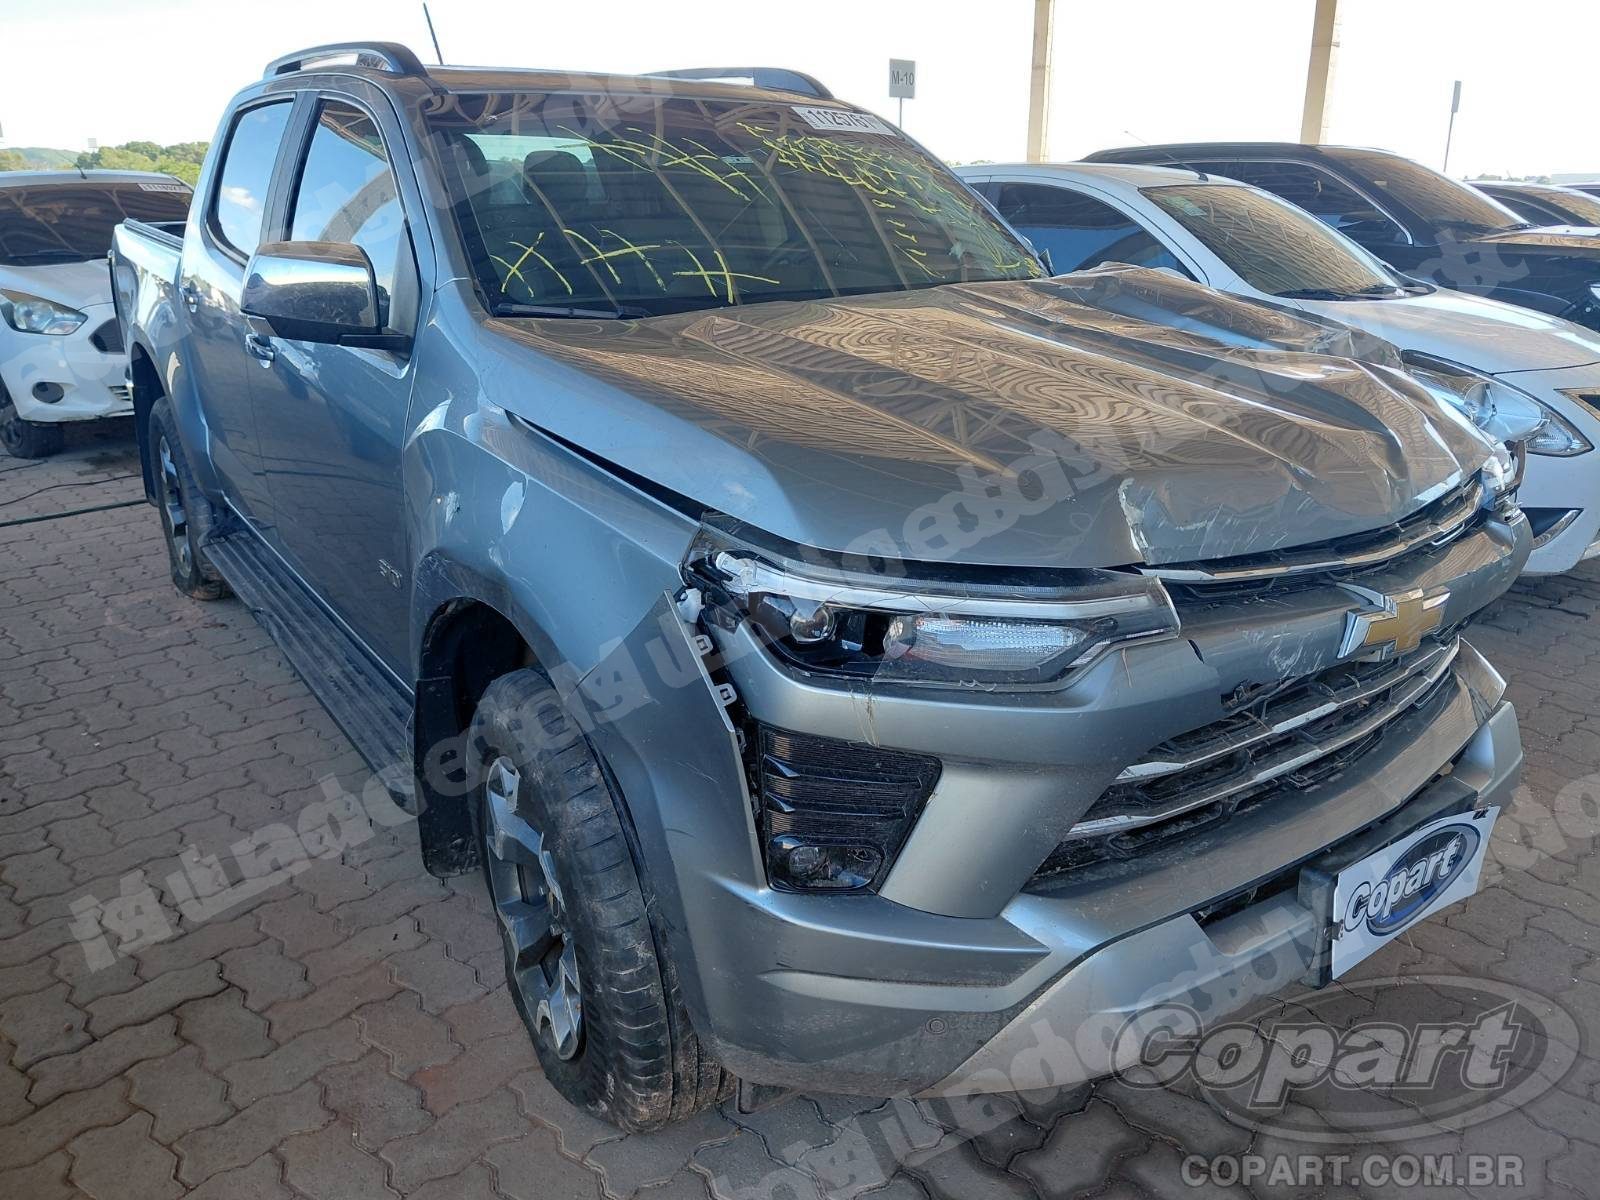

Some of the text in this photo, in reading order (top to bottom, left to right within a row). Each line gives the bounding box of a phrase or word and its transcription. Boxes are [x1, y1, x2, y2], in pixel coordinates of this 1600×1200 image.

[891, 70, 915, 86] M-10
[807, 109, 878, 130] 1125761
[1344, 832, 1462, 932] Copart
